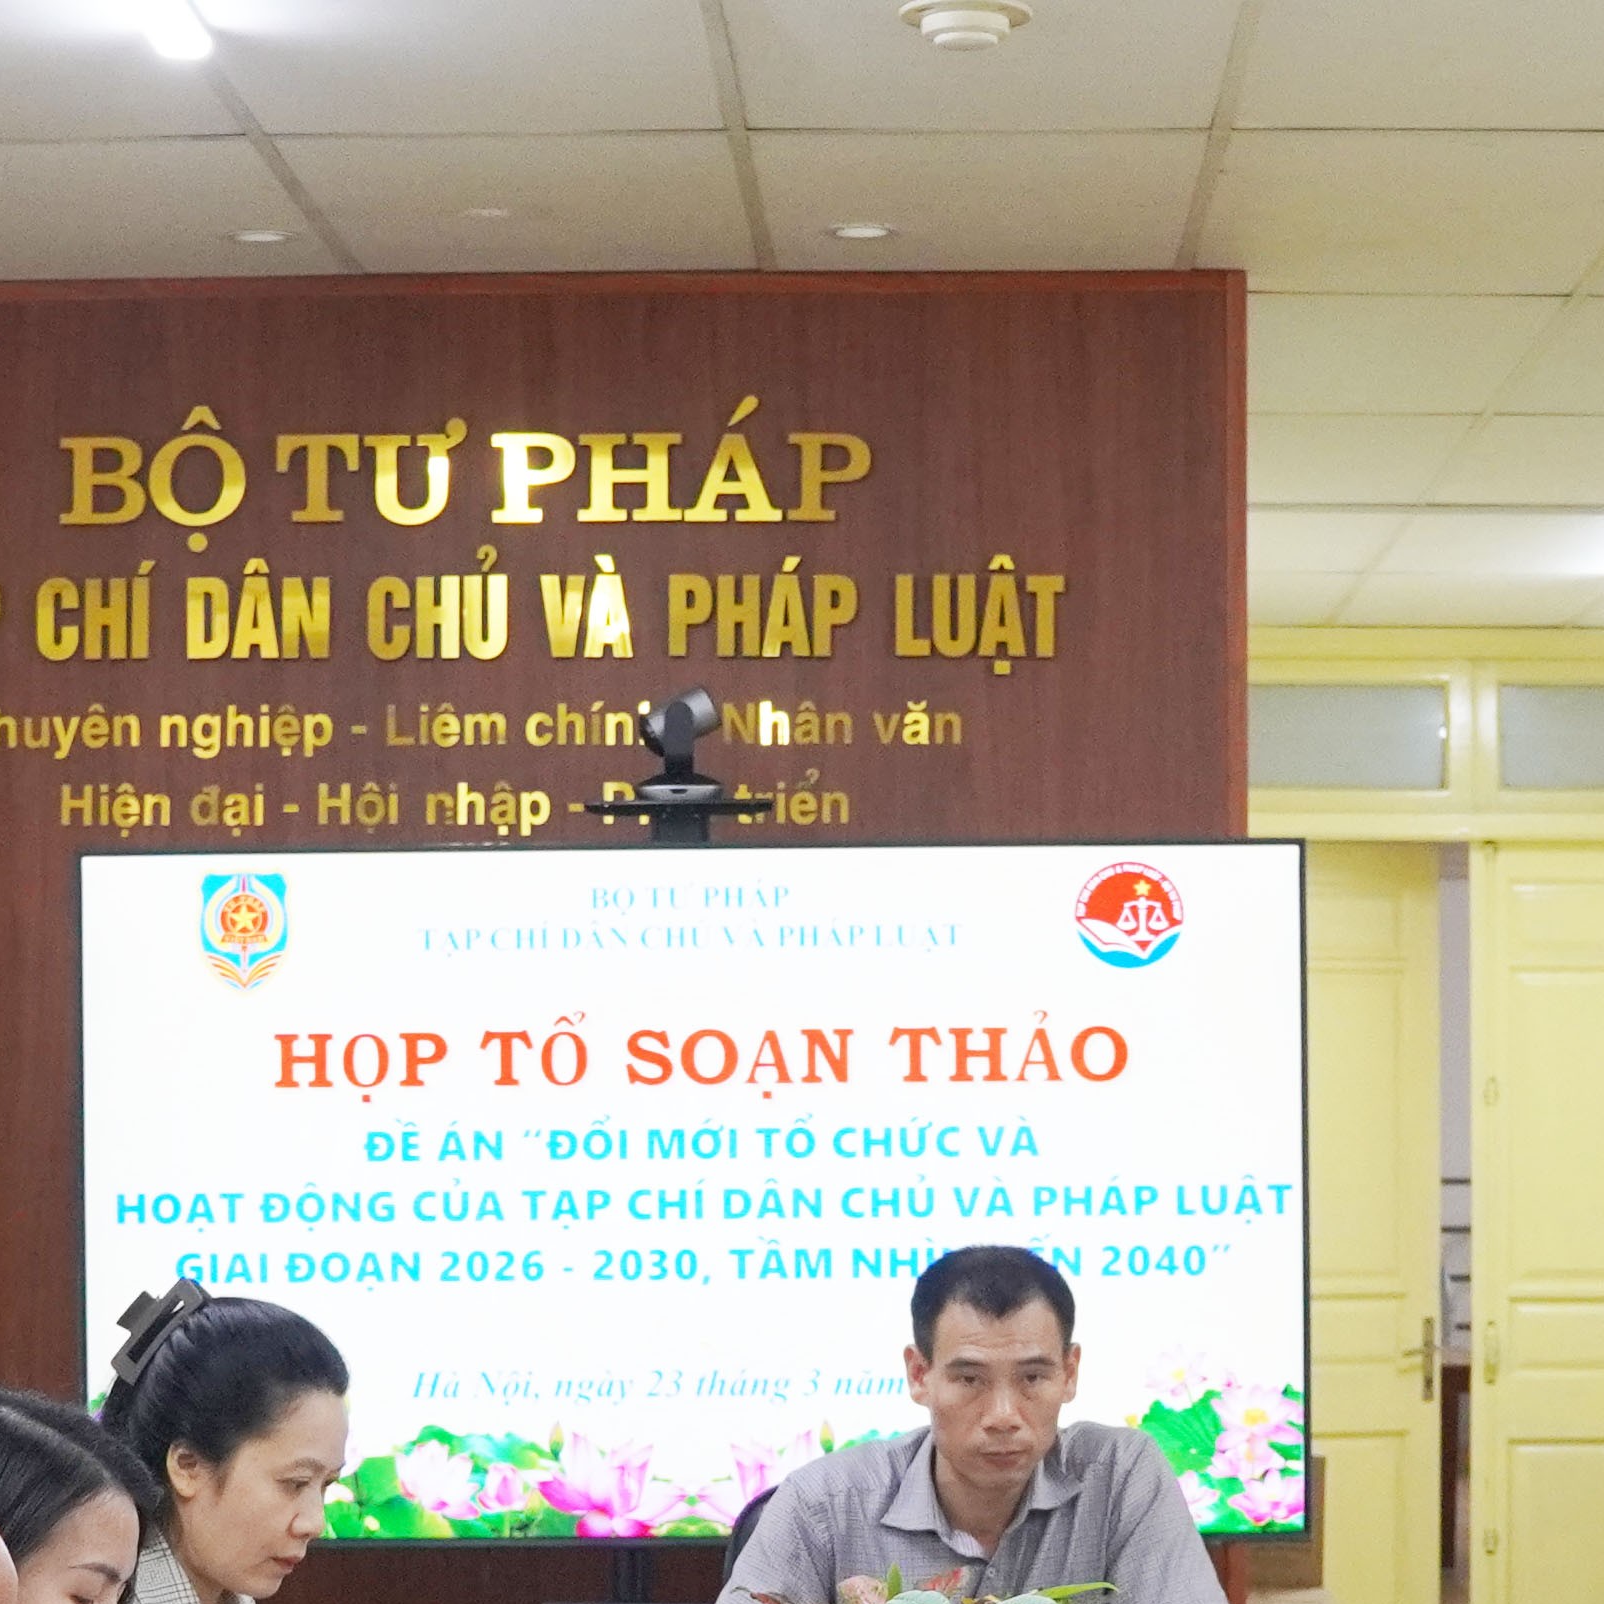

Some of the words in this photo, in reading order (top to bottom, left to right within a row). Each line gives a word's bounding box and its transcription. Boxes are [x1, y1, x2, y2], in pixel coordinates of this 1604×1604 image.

[59, 405, 246, 552] BỘ
[276, 417, 467, 526] TƯ
[490, 395, 872, 523] PHÁP
[35, 559, 156, 661] CHÍ
[185, 557, 331, 661] DÂN
[367, 544, 509, 661] CHỦ
[539, 553, 634, 659] VÀ
[667, 554, 858, 659] PHÁP
[895, 553, 1066, 676] LUẬT
[159, 704, 334, 758] nghiệp
[385, 703, 507, 748] Liêm
[722, 700, 853, 747] Nhân
[873, 700, 963, 747] văn
[59, 782, 171, 838] Hiện
[189, 783, 266, 837] đại
[316, 781, 399, 834] Hội
[426, 780, 552, 837] nhập
[733, 768, 851, 825] triển
[703, 878, 791, 910] PHÁP
[417, 926, 482, 957] TẠP
[489, 922, 549, 952] CHÍ
[561, 918, 630, 951] DÂN
[778, 917, 866, 949] PHÁP
[873, 917, 965, 953] LUẬT
[273, 1032, 449, 1103] HỌP
[479, 1010, 590, 1087] TỔ
[625, 1028, 855, 1100] SOẠN
[887, 1009, 1130, 1084] THẢO
[363, 1118, 422, 1162] ĐỀ
[437, 1121, 505, 1162] ÁN
[646, 1117, 739, 1161] MỚI
[755, 1112, 817, 1160] TỔ
[831, 1116, 962, 1159] CHỨC
[976, 1115, 1041, 1158] VÀ
[116, 1191, 246, 1234] HOẠT
[260, 1180, 398, 1233] ĐỘNG
[411, 1176, 506, 1223] CỦA
[521, 1188, 612, 1231] TẠP
[627, 1177, 705, 1222] CHÍ
[722, 1177, 824, 1220] DÂN
[839, 1173, 936, 1219] CHỦ
[953, 1173, 1015, 1218] VÀ
[1032, 1174, 1160, 1218] PHÁP
[1175, 1173, 1295, 1224] LUẬT
[175, 1251, 270, 1286] GIAI
[283, 1250, 422, 1292] ĐOẠN
[438, 1249, 546, 1283] 2026
[592, 1248, 712, 1286] 2030,
[728, 1237, 834, 1281] TẦM
[850, 1237, 952, 1280] NHÌ
[411, 1369, 462, 1399] Hà
[472, 1369, 541, 1407] Nội,
[553, 1369, 634, 1405] ngày
[645, 1369, 684, 1398] 23
[694, 1368, 792, 1405] tháng
[801, 1367, 821, 1397] 3
[833, 1371, 907, 1397] năm
